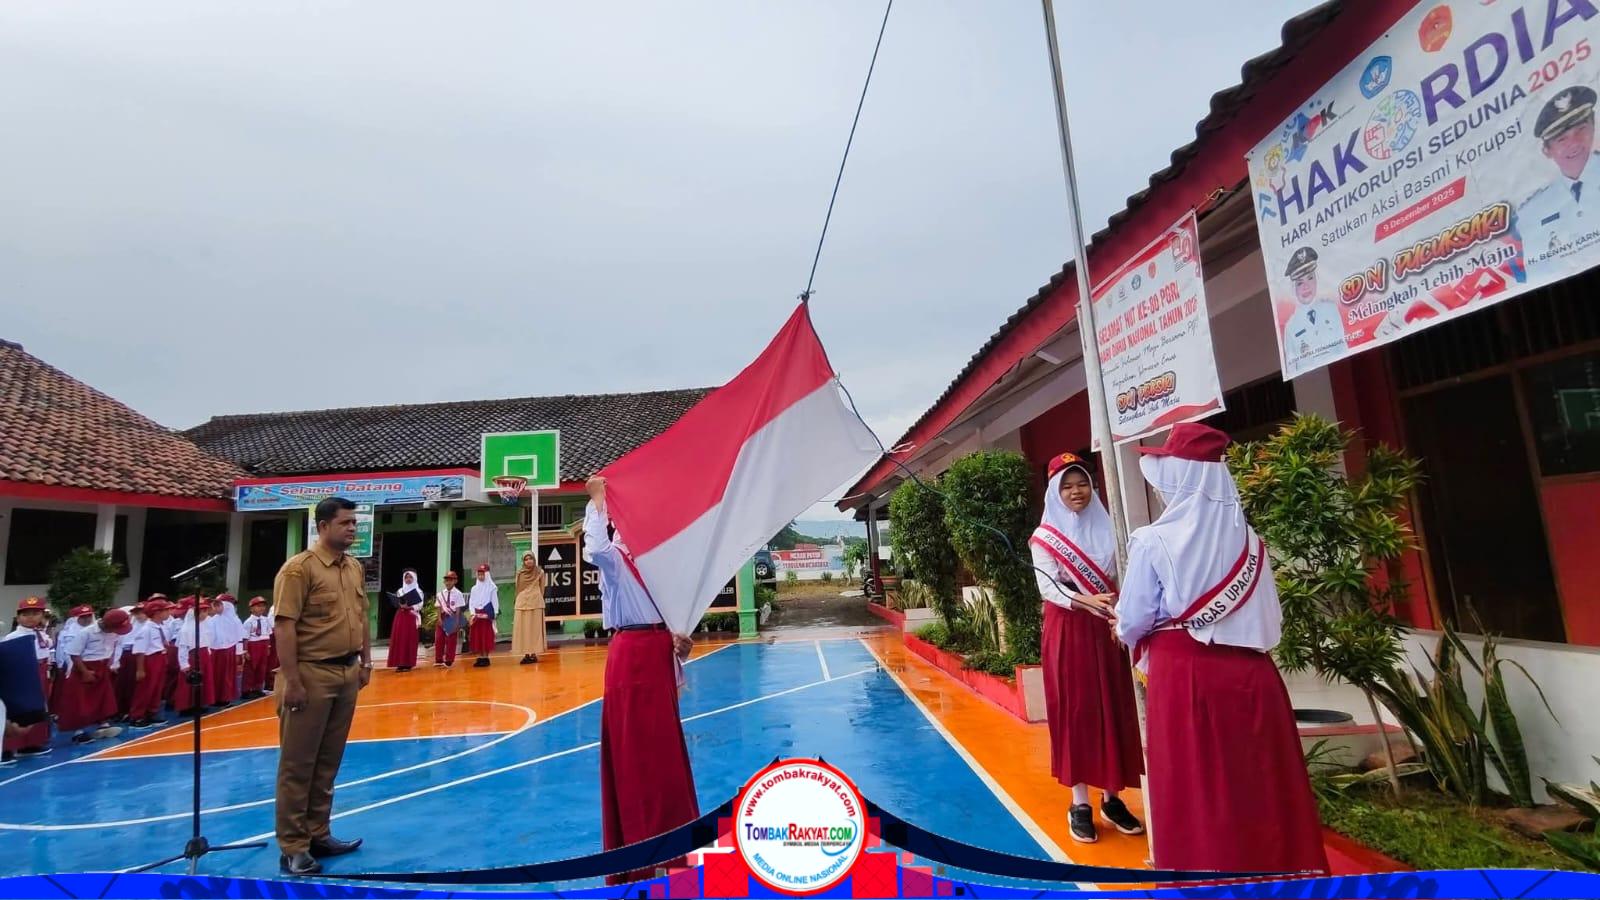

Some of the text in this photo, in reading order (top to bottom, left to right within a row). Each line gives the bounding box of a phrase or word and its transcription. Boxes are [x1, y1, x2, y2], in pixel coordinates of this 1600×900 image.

[1281, 221, 1312, 248] HARI
[1314, 147, 1423, 228] ANTIKORUPSI
[1428, 83, 1527, 155] SEDUNIA
[1528, 37, 1592, 93] 2025
[1321, 117, 1522, 247] Satukan Aksi Basmi Korupsi
[1390, 203, 1431, 229] Desember
[1431, 187, 1455, 206] 2025
[1540, 242, 1573, 260] BENNY
[1575, 229, 1600, 247] KARN
[1349, 245, 1515, 324] Melangkah Lebih Maju
[1098, 315, 1122, 345] SELAMAT
[1160, 280, 1180, 307] PGRI
[1127, 320, 1157, 348] NASIONAL
[1159, 304, 1183, 331] TAHUN
[280, 485, 339, 495] Selamat
[344, 482, 402, 492] Datang
[1044, 533, 1077, 563] PETUGAS
[1224, 553, 1258, 602] UPACARA
